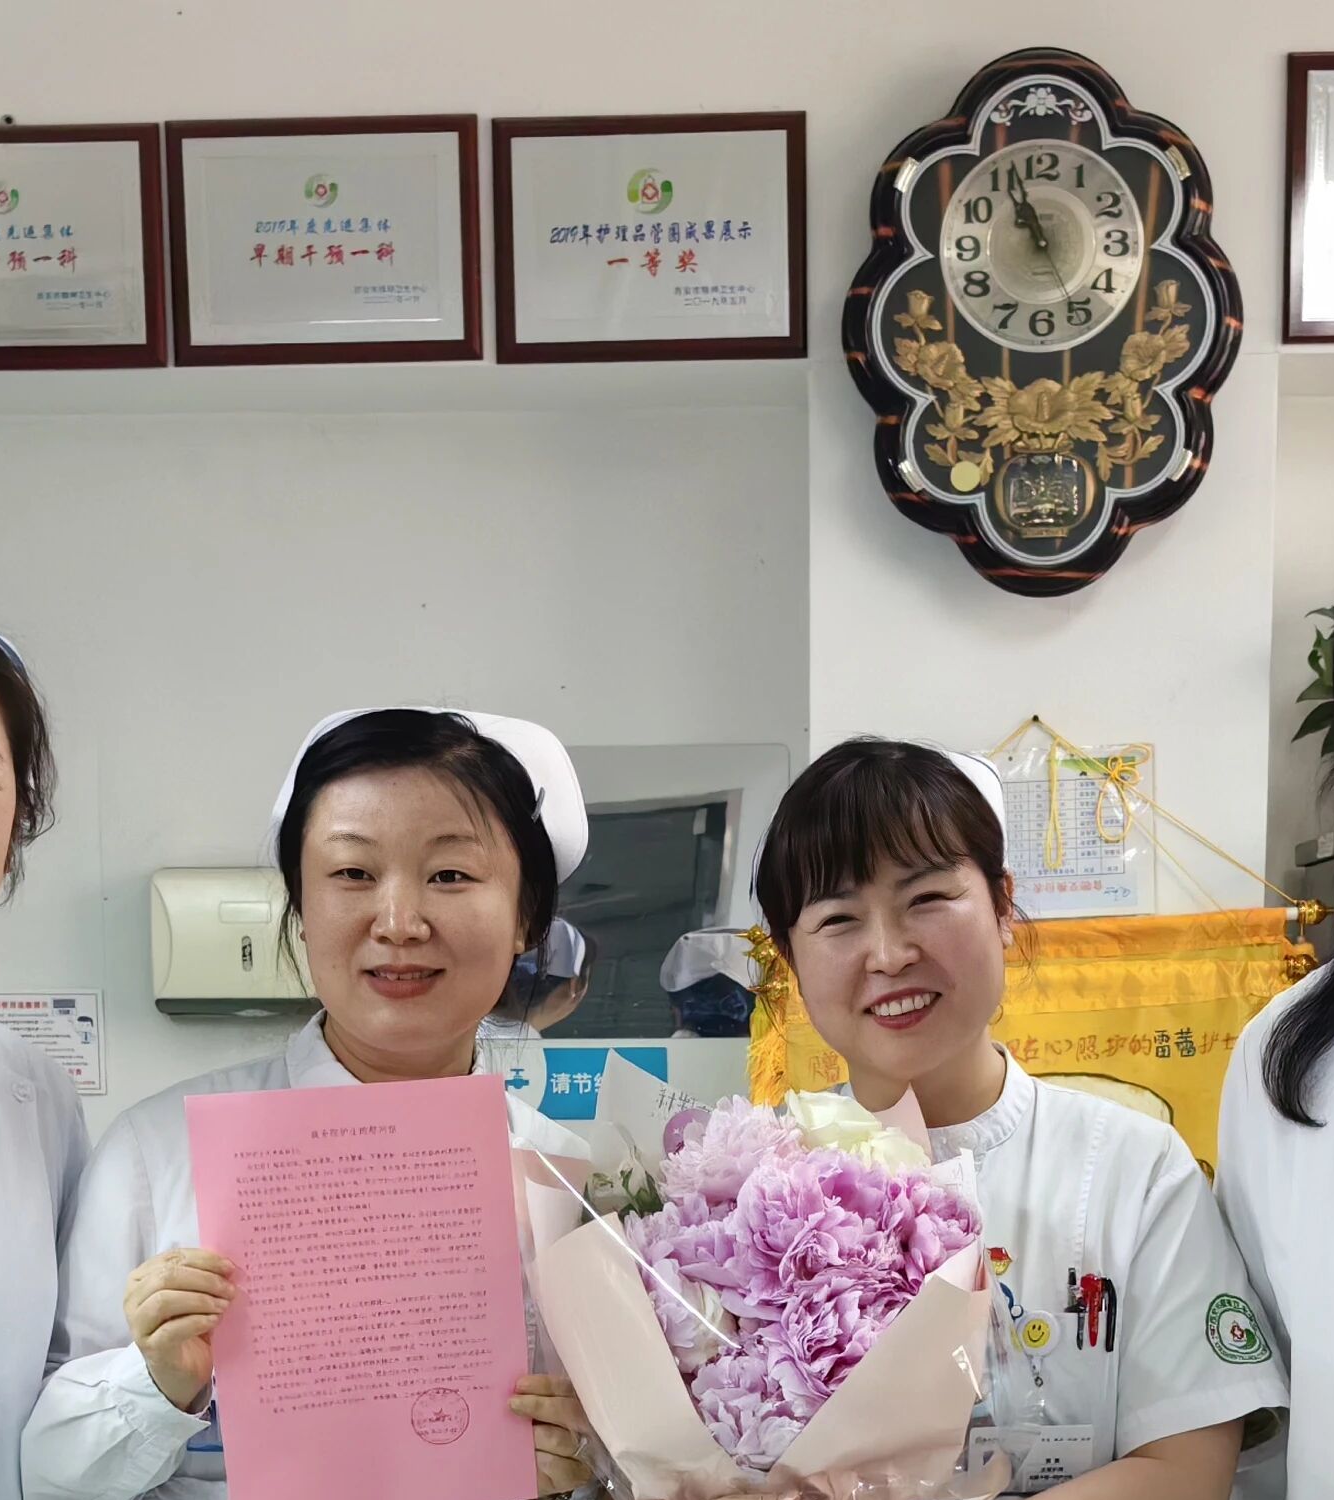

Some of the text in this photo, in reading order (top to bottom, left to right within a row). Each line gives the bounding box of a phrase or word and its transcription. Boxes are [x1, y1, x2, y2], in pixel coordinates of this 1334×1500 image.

[1025, 152, 1060, 181] 12
[1074, 163, 1085, 188] 1
[963, 196, 993, 224] 10
[1096, 191, 1123, 218] 2
[250, 240, 395, 267] 早期干预一科
[955, 235, 981, 262] 9
[1103, 229, 1130, 257] 3
[607, 247, 699, 278] 一等奖
[963, 270, 991, 298] 8
[1091, 267, 1115, 294] 4
[992, 302, 1018, 329] 7
[1028, 309, 1055, 337] 6
[1067, 298, 1093, 326] 5
